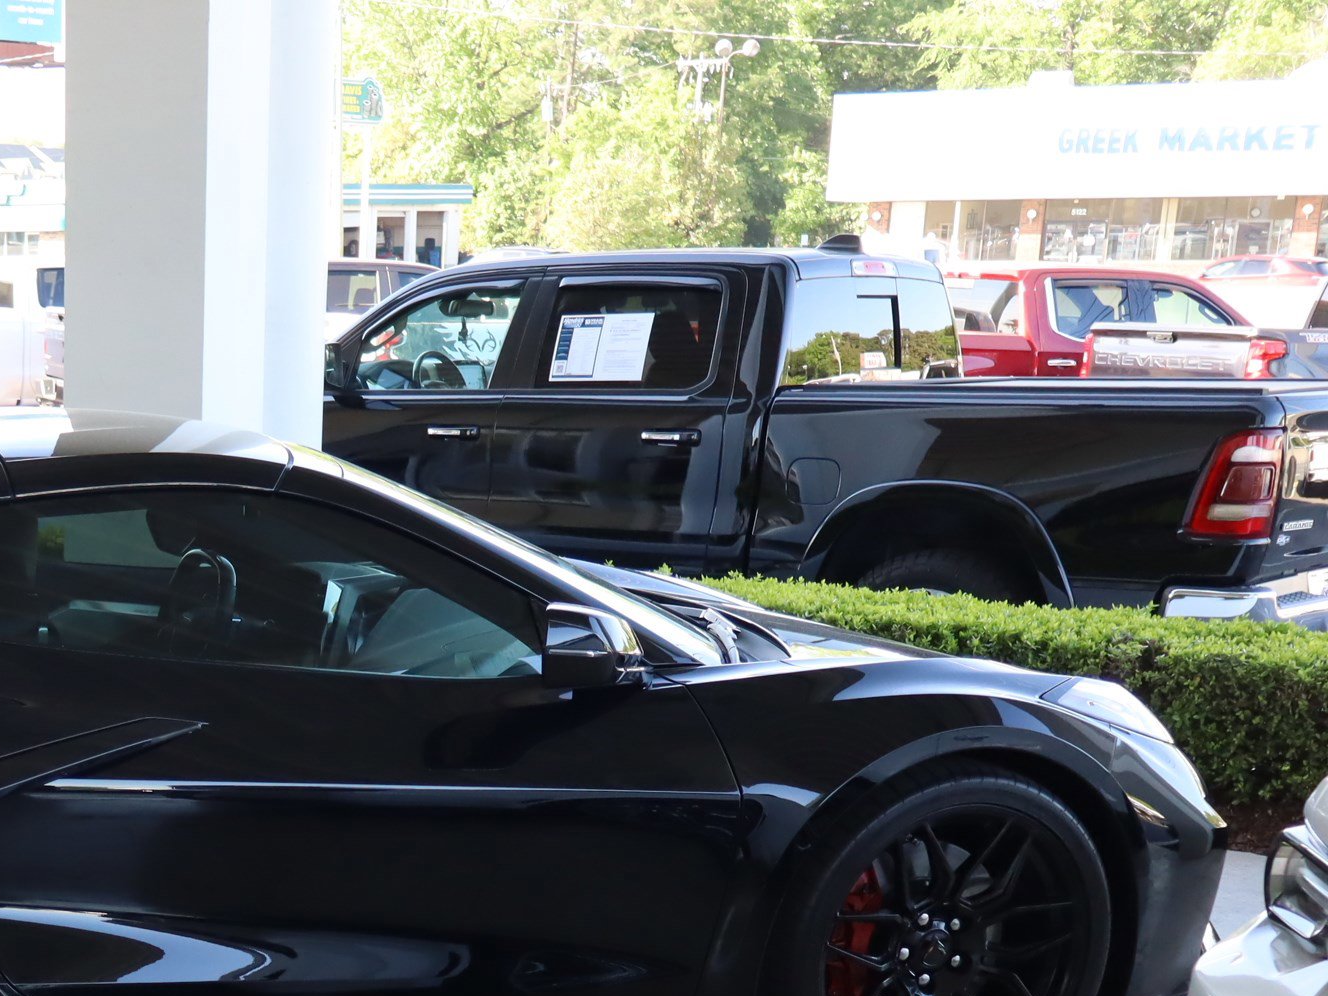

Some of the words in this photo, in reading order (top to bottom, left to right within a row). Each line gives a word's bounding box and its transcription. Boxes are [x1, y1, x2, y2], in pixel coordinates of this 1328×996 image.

[1058, 128, 1139, 154] GREEK
[1158, 124, 1321, 152] MARKET
[1094, 351, 1232, 372] CHEVROLET
